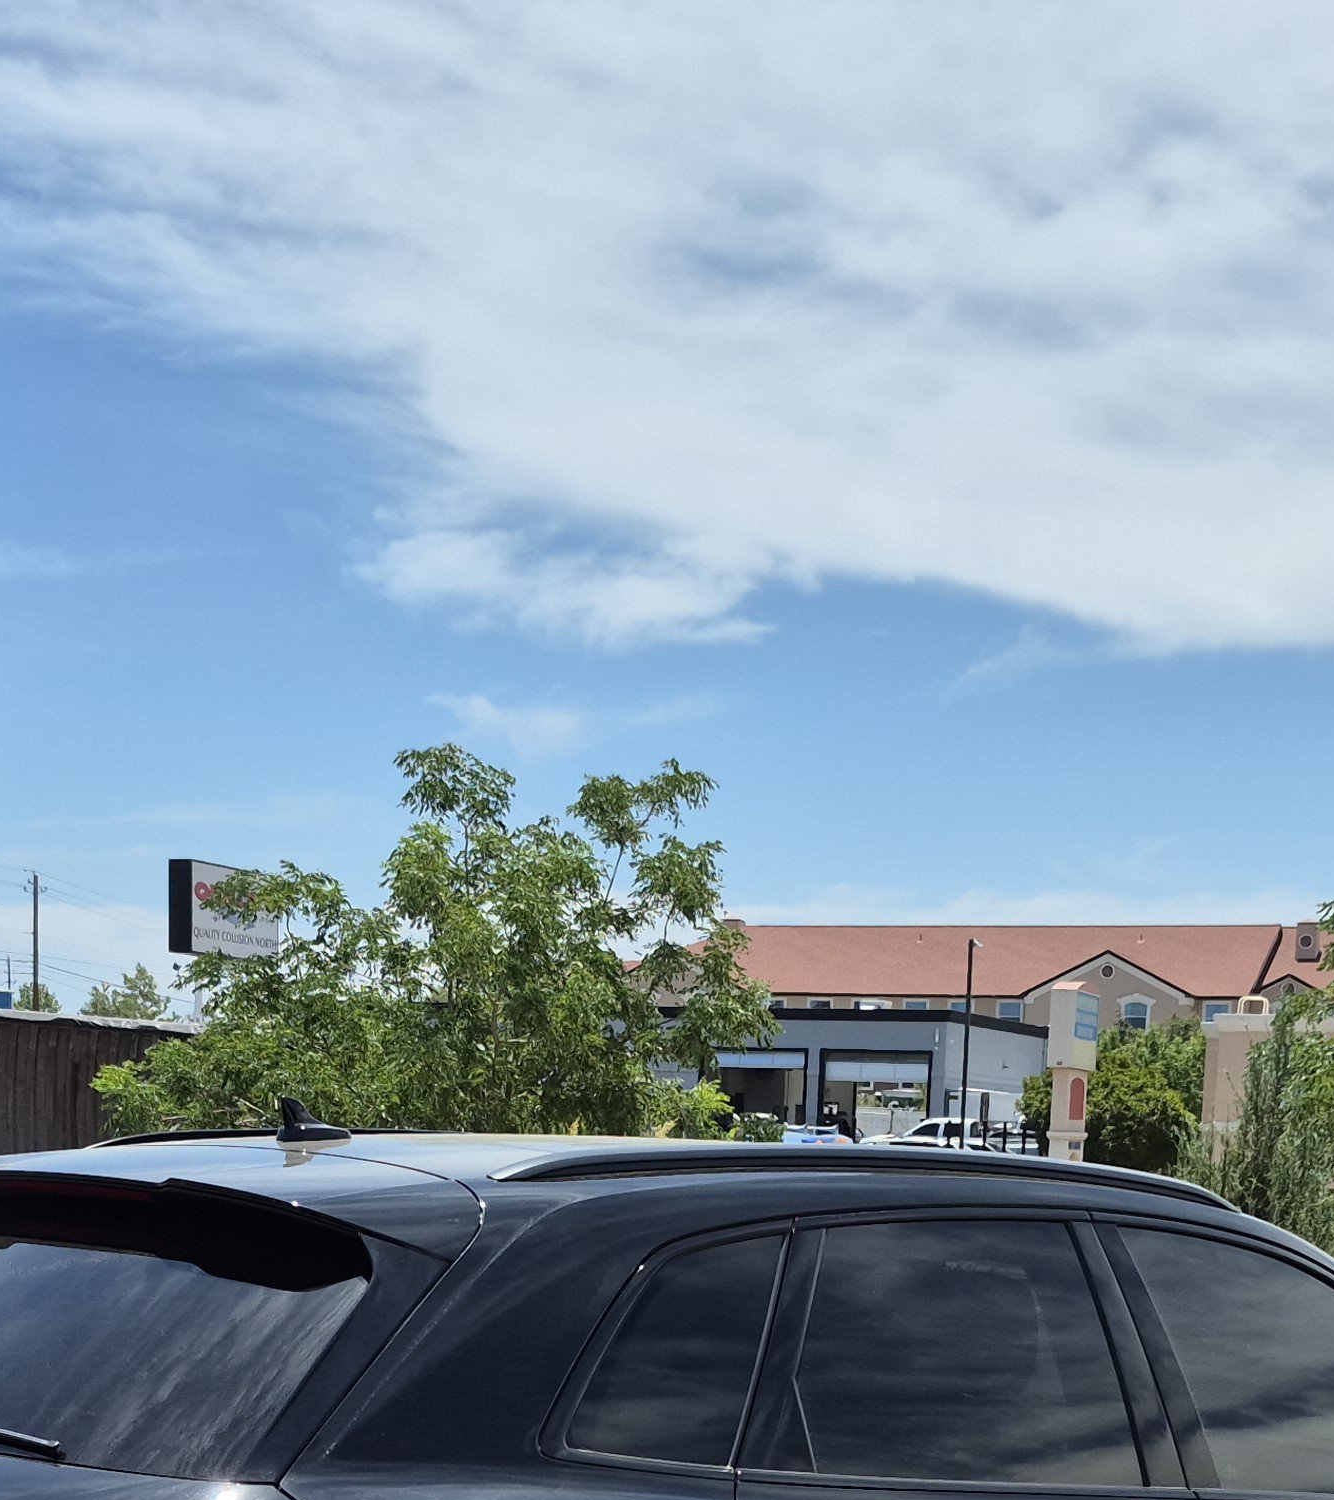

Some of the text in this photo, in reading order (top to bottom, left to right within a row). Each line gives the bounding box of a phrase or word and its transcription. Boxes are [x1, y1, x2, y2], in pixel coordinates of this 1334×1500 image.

[193, 926, 277, 950] QUALITY COLLISION NORTH
